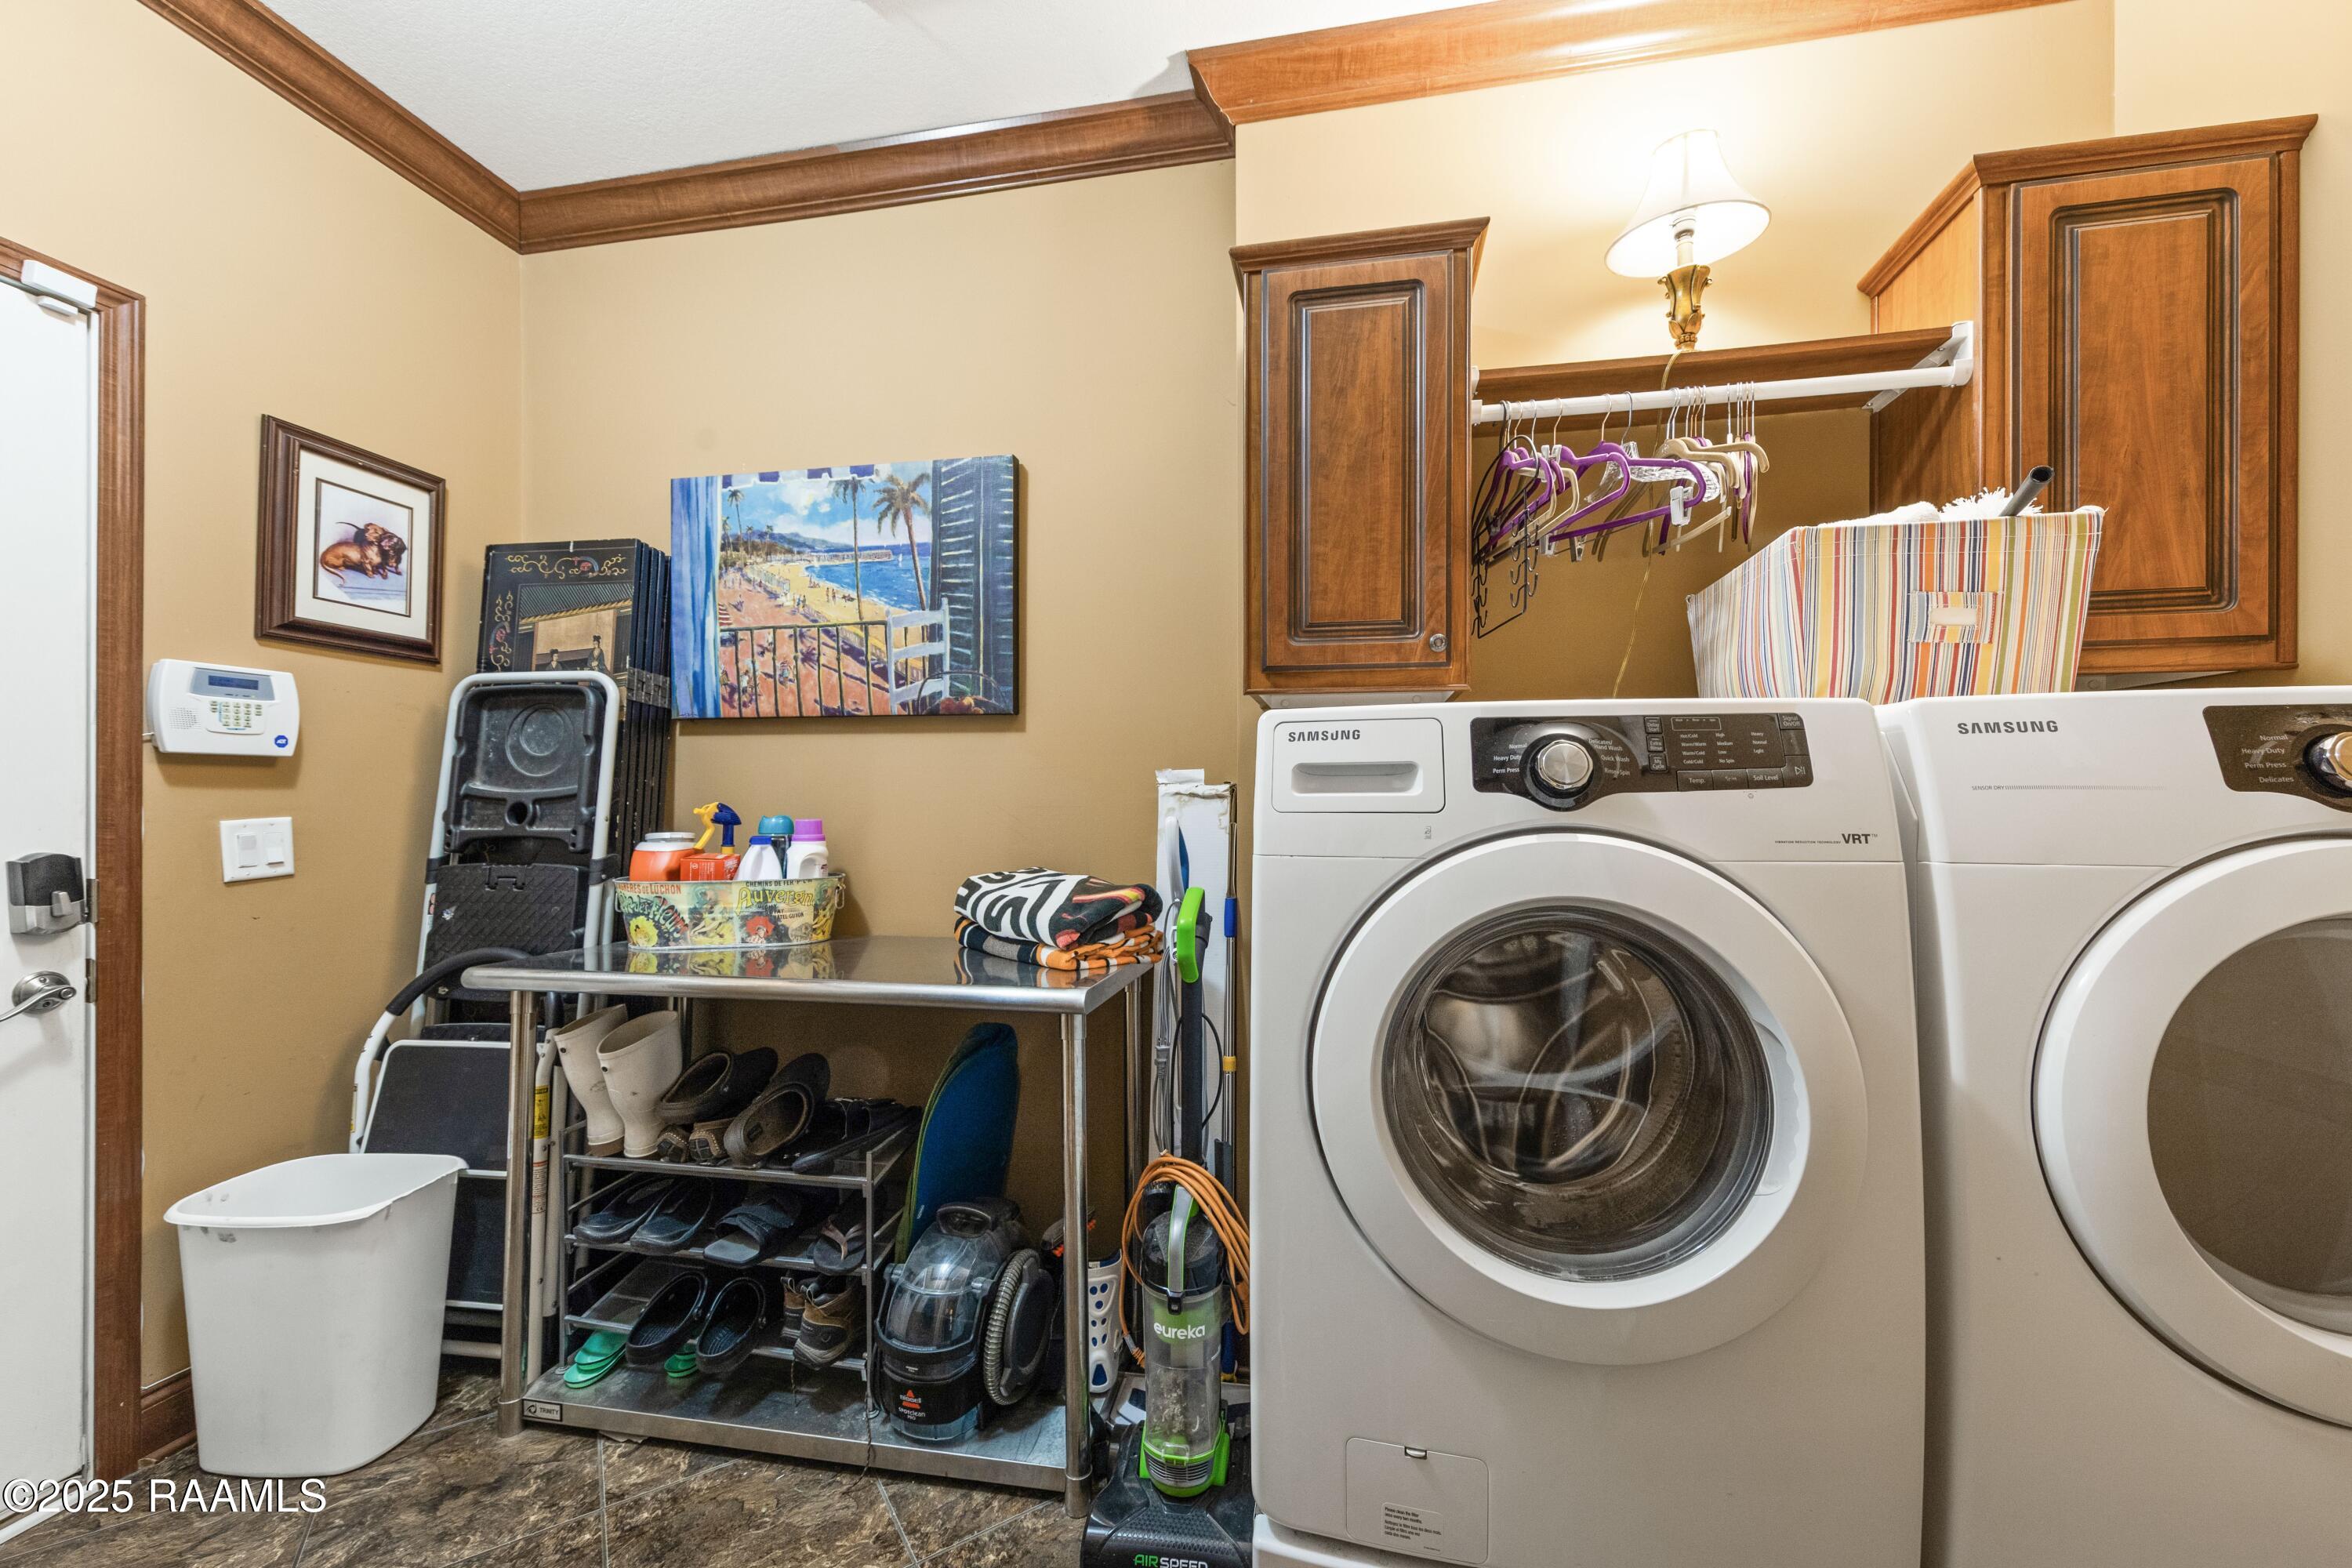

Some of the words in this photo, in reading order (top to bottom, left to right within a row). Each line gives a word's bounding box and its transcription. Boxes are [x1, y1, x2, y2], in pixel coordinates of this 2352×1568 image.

[1957, 720, 2058, 734] SAMSUNG
[1288, 729, 1360, 742] SAMSUNG
[650, 884, 681, 894] LUCHON
[1153, 1322, 1205, 1340] eureka
